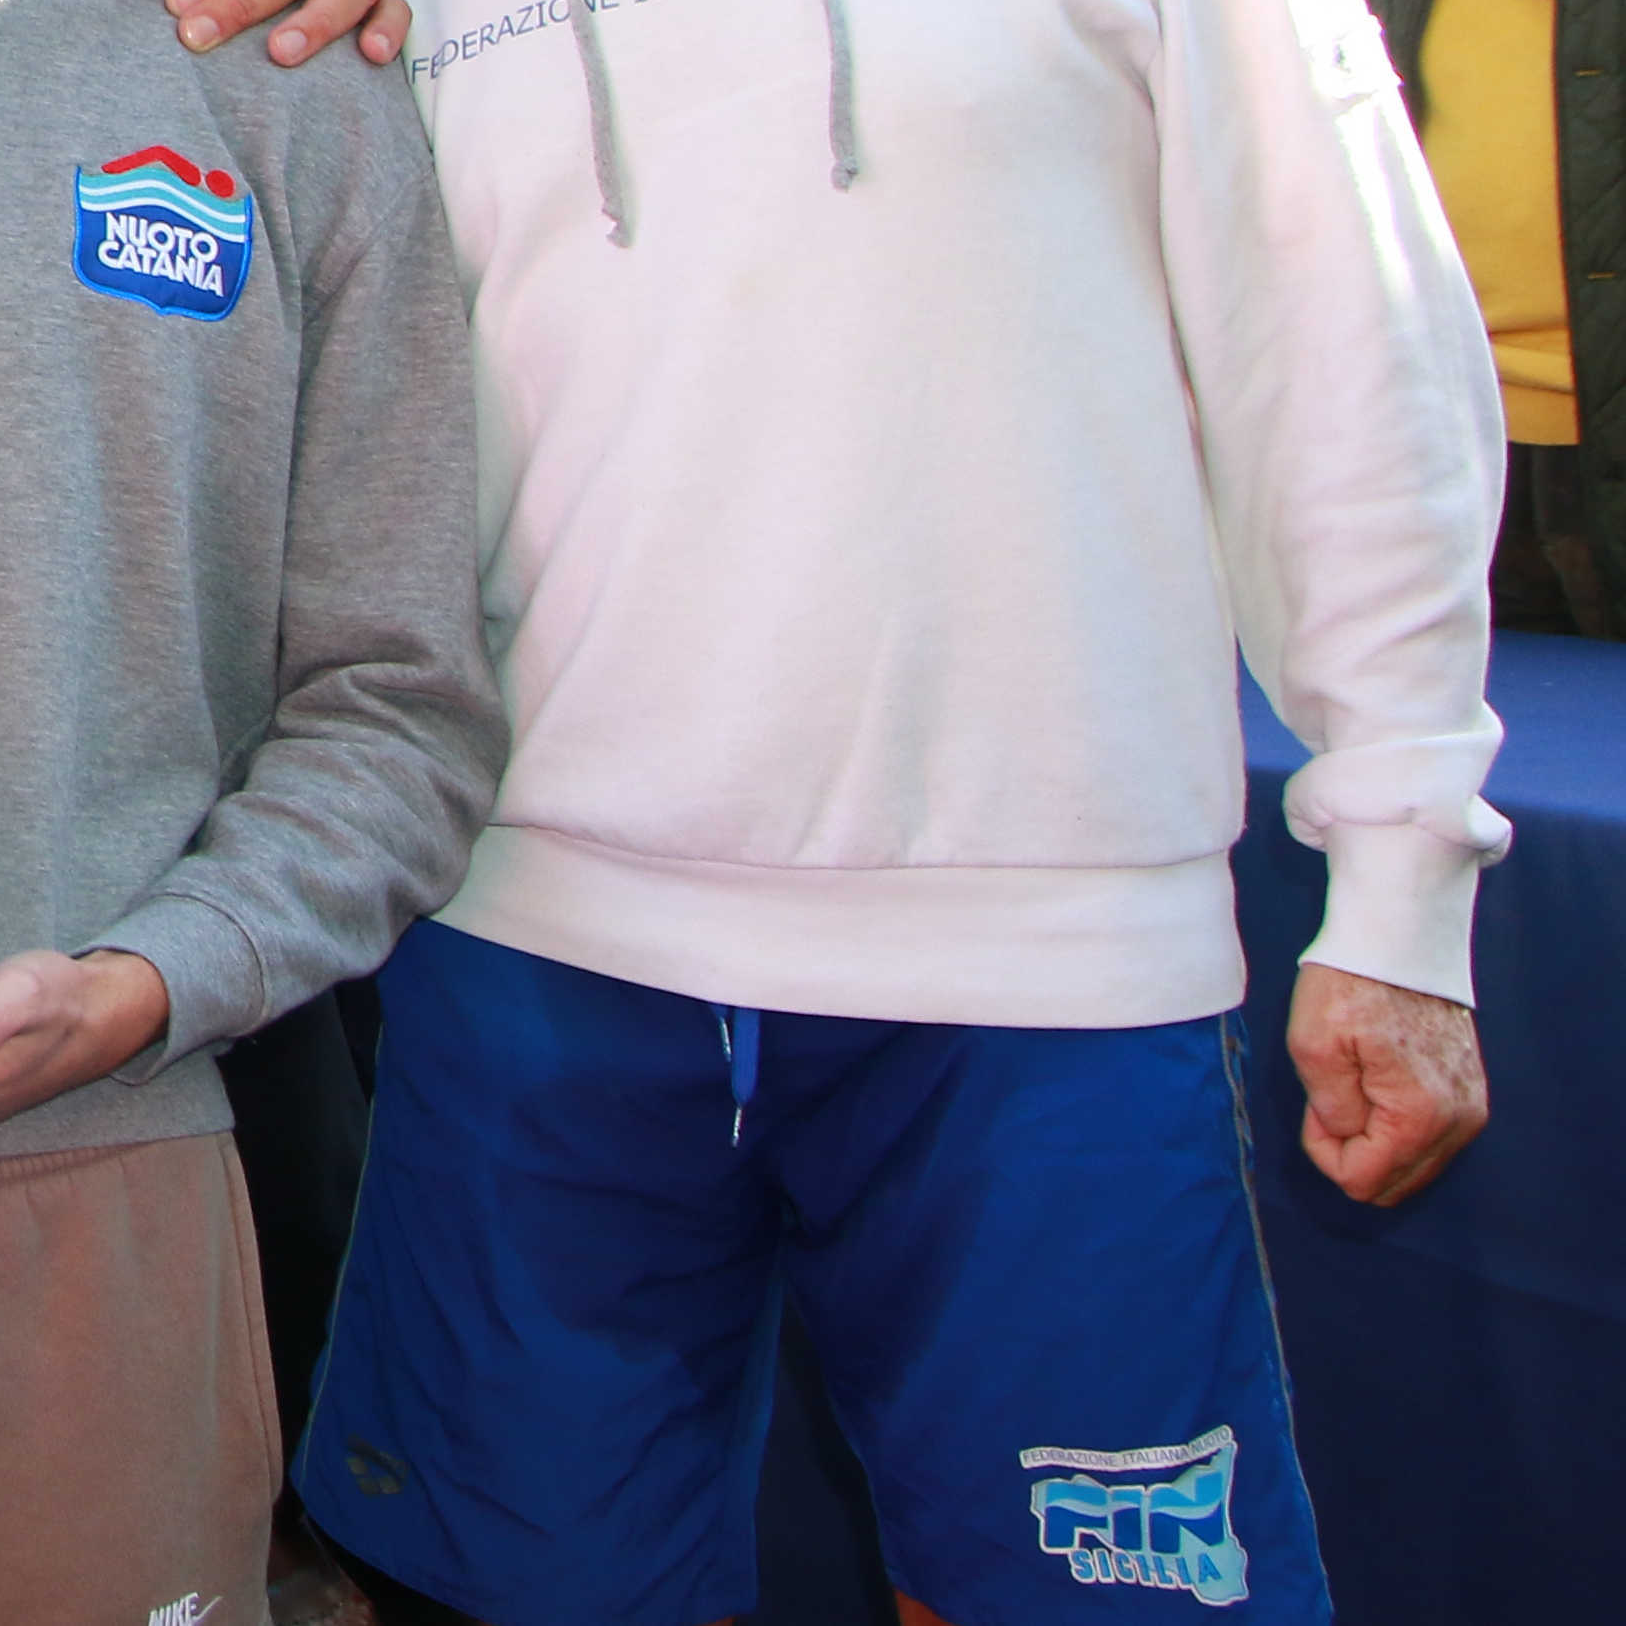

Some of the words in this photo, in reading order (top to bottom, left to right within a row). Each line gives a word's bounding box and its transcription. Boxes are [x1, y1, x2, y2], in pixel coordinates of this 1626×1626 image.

[105, 211, 220, 264] NUOTO
[98, 240, 224, 298] CATANIA
[1022, 1449, 1117, 1467] FEDERAZIONE
[1122, 1446, 1190, 1465] ITALIANA
[1190, 1427, 1230, 1455] NUOTO
[1071, 1548, 1223, 1585] SICILIA
